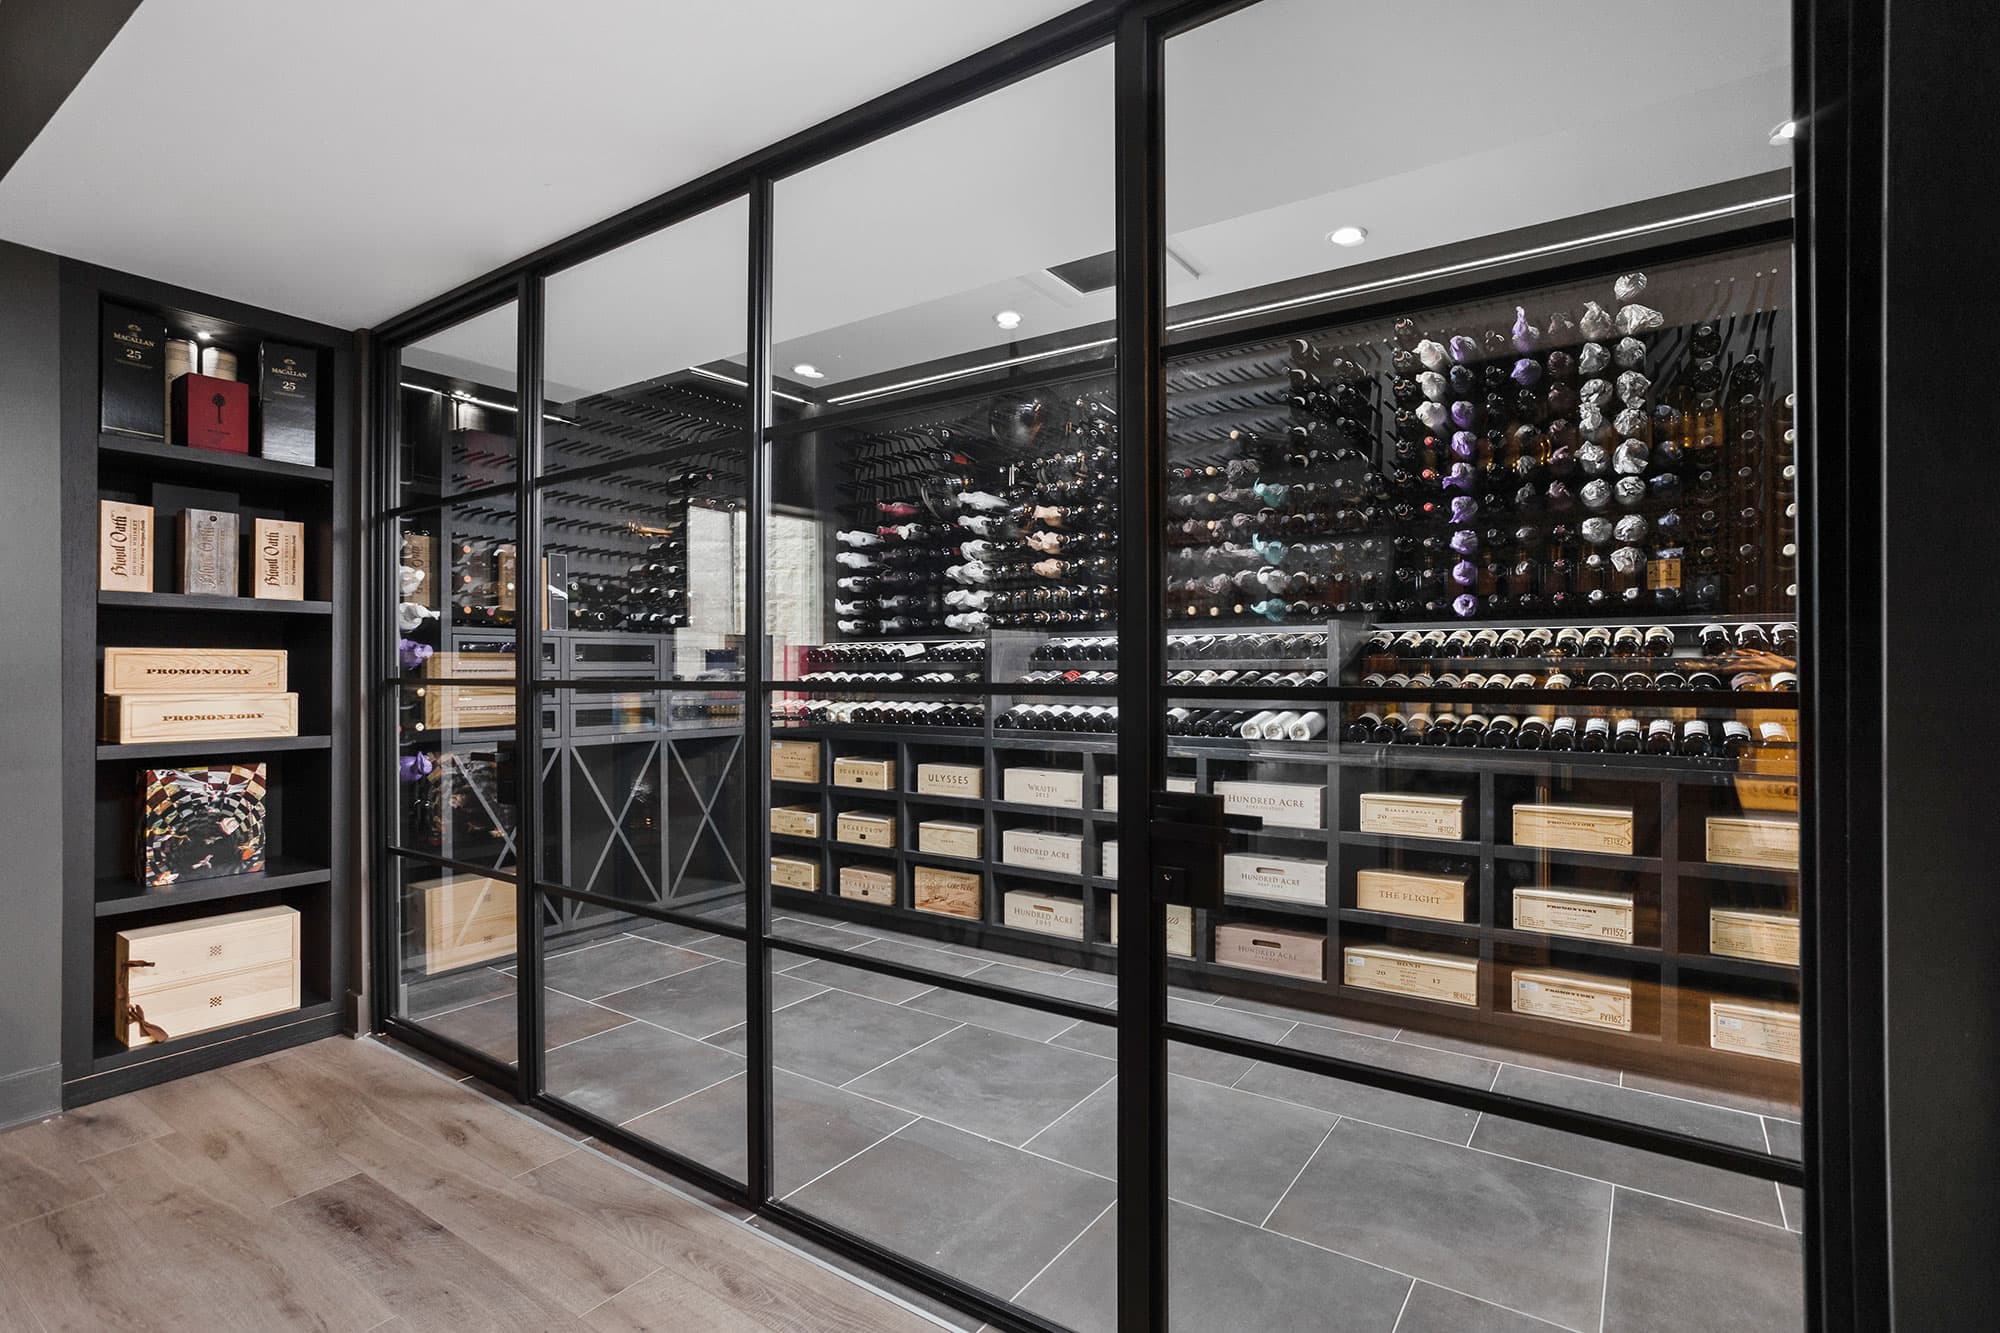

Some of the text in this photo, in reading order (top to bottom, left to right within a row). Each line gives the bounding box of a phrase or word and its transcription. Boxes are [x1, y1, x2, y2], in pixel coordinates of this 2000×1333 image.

[113, 332, 155, 348] MACALLAN
[126, 348, 142, 360] 25
[272, 368, 308, 378] MACALLAN
[282, 381, 296, 392] 25
[110, 516, 128, 542] Oath
[264, 531, 280, 556] Oath
[161, 712, 265, 722] PROMONTORY
[928, 774, 969, 785] ULYSSES
[1228, 794, 1305, 808] HUNDRED ACRE
[1013, 844, 1070, 860] HUNDRED ACRE
[1241, 873, 1300, 886] HUNDRED ACRE
[1379, 890, 1441, 904] THE FLIGHT
[1014, 907, 1073, 924] HUNDRED ACRE
[1238, 945, 1276, 956] HUNDRED
[1277, 952, 1297, 960] ACRE
